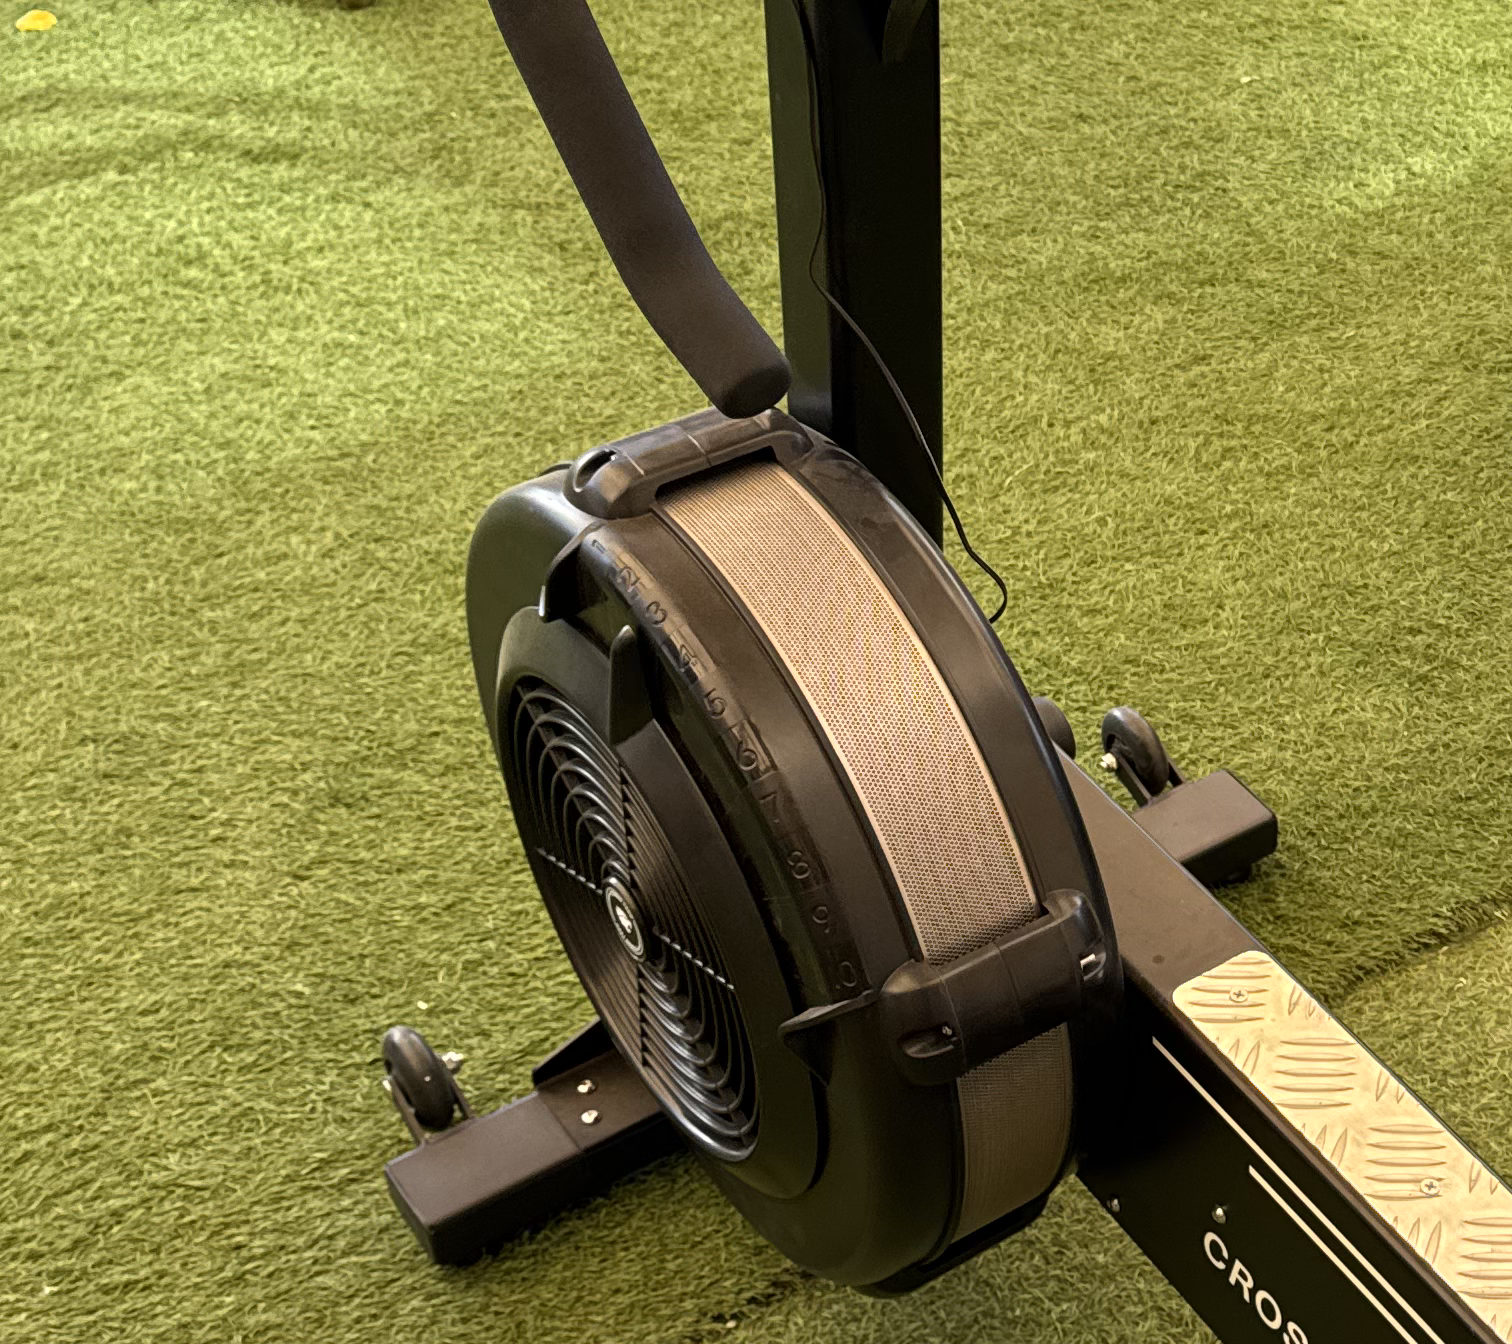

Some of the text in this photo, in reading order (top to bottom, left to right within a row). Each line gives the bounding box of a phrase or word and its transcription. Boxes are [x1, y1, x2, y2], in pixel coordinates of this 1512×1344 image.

[646, 600, 667, 625] 3
[704, 688, 726, 717] 5
[736, 740, 757, 771] 6
